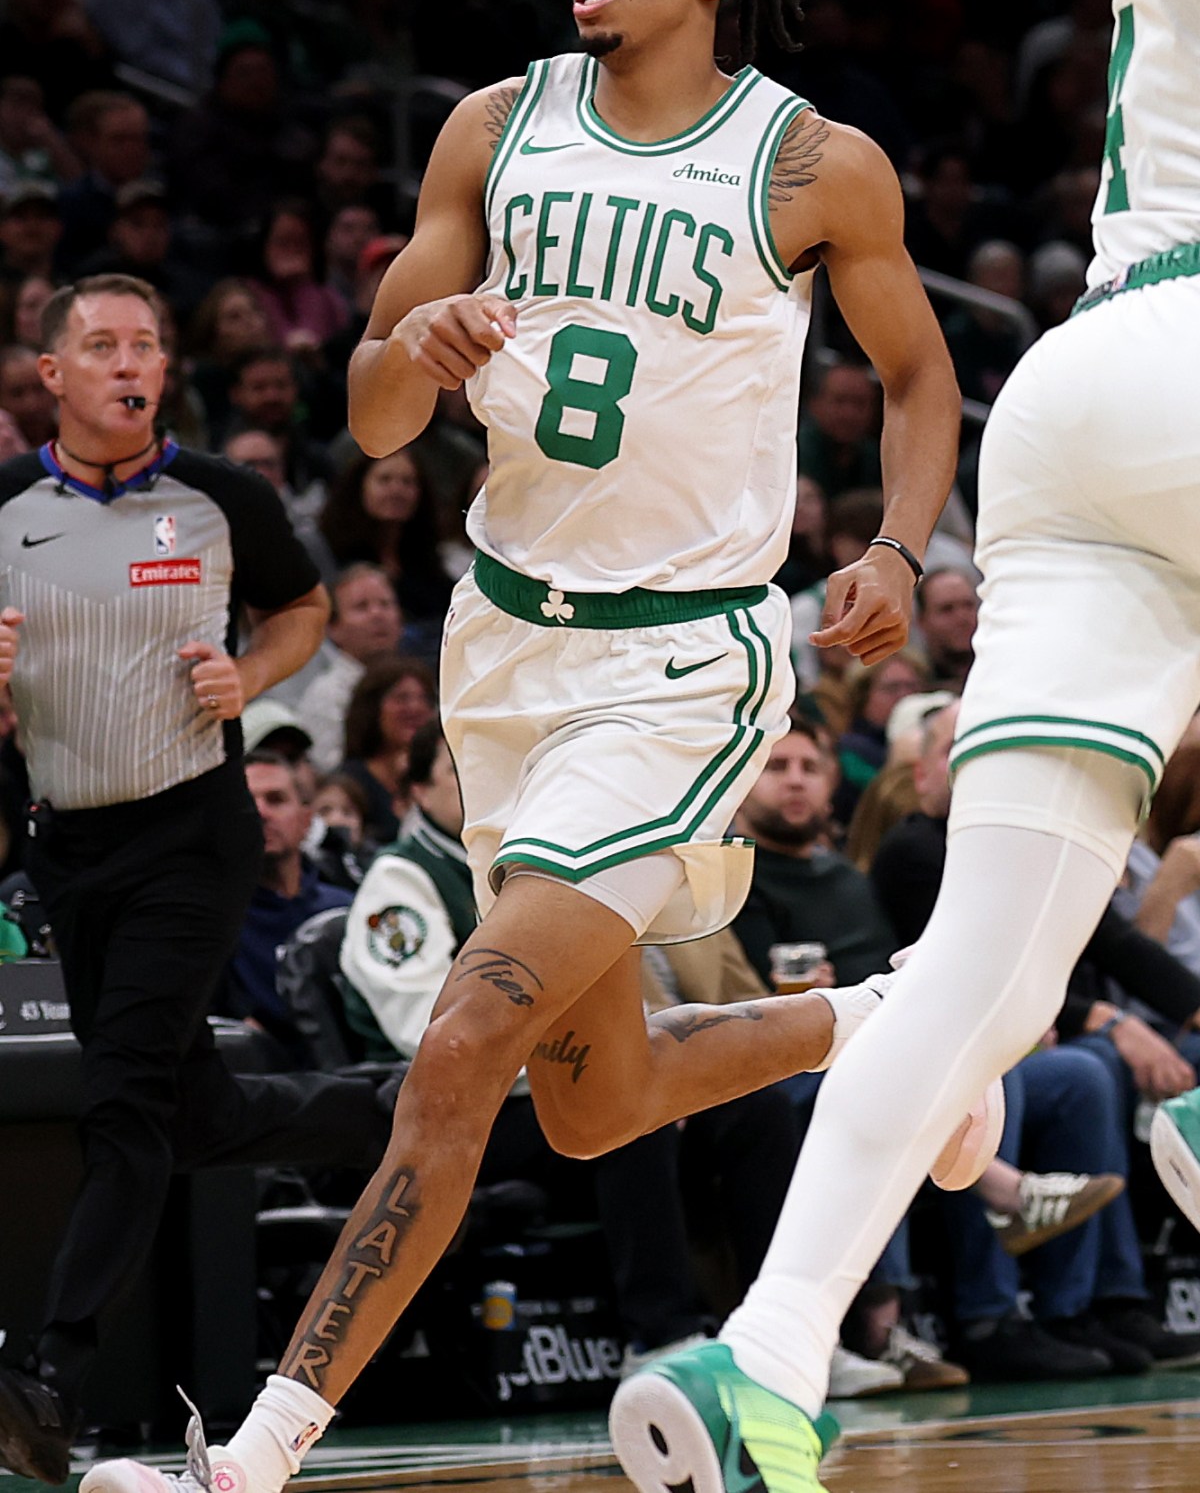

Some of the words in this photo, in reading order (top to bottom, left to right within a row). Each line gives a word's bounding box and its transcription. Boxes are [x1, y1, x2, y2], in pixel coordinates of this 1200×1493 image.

[672, 163, 741, 187] Amica
[503, 191, 735, 335] CELTICS
[534, 323, 638, 470] 8
[131, 564, 199, 583] Emirates
[283, 1170, 412, 1390] LATER
[498, 1322, 622, 1401] tBlue
